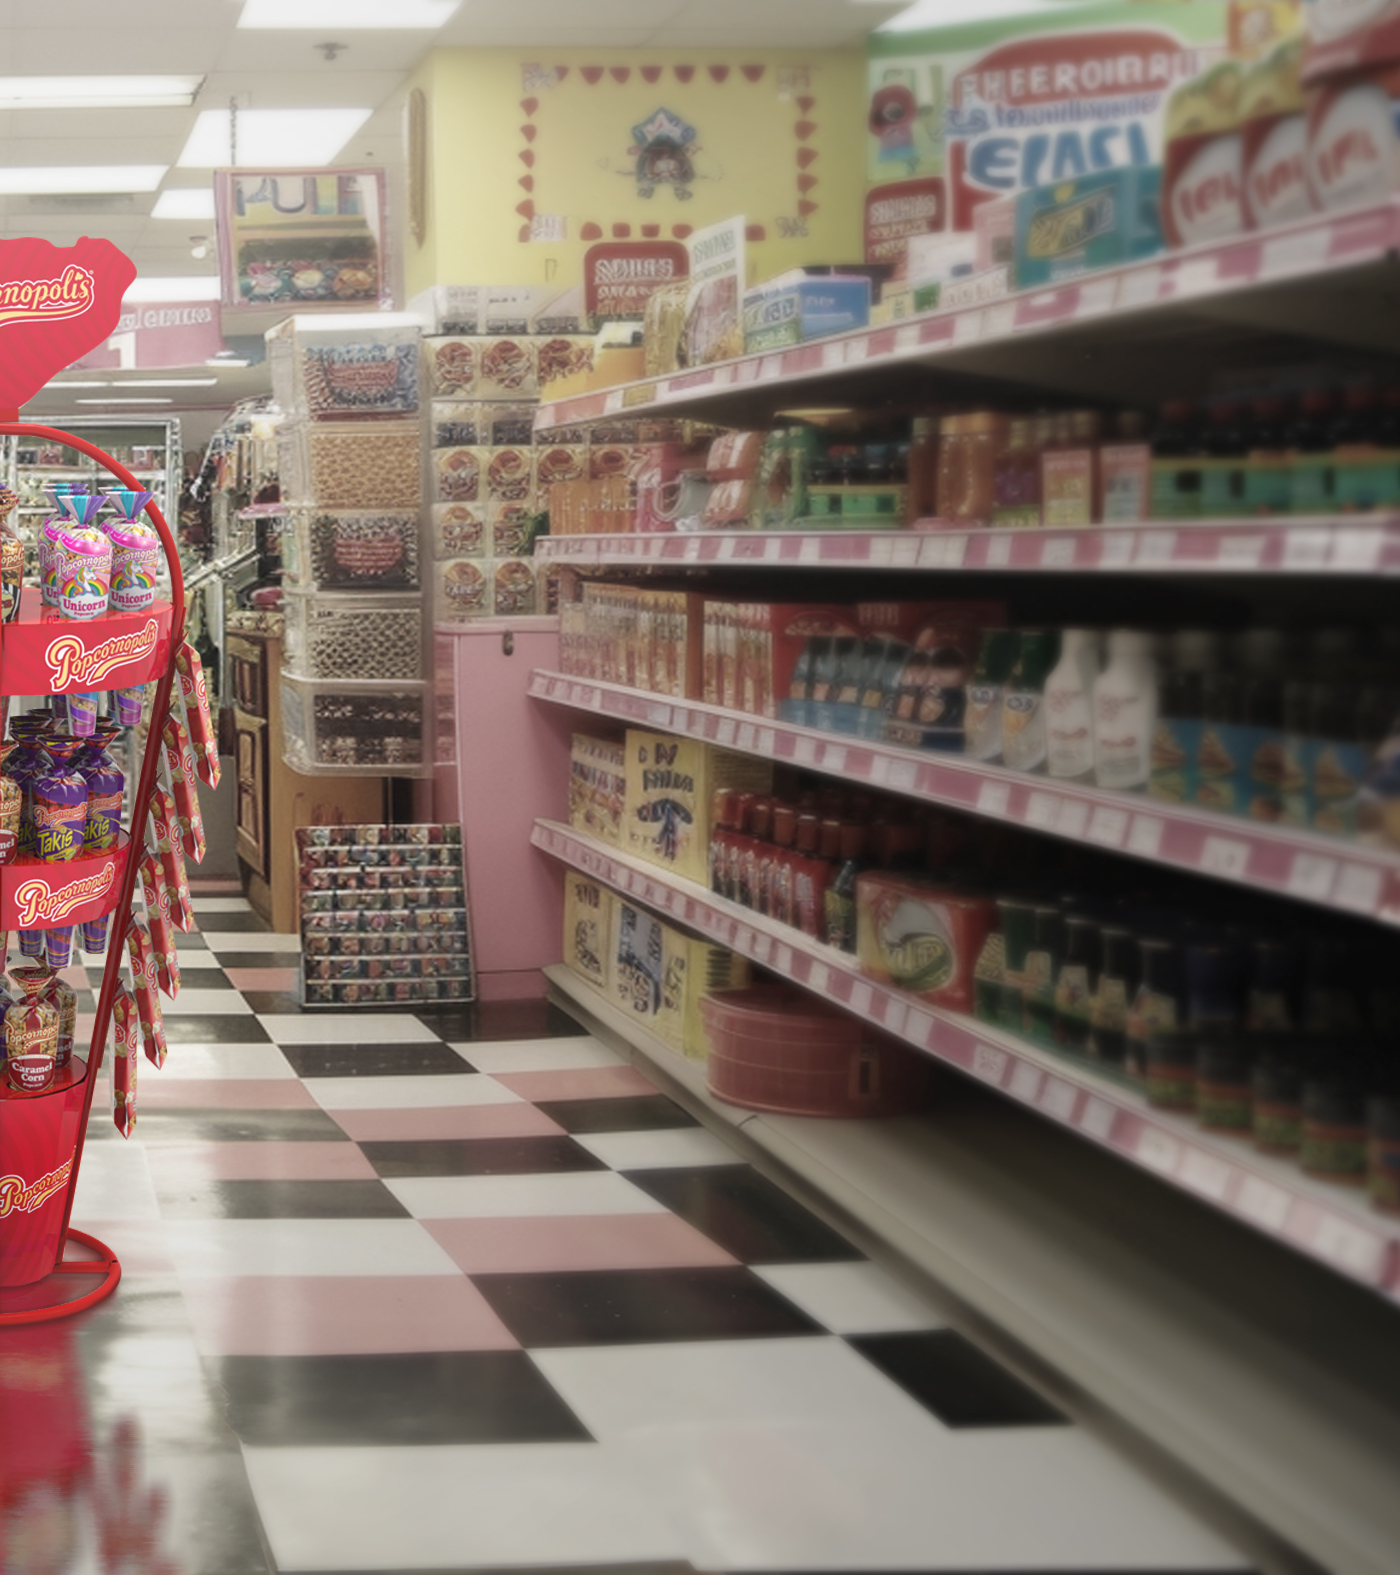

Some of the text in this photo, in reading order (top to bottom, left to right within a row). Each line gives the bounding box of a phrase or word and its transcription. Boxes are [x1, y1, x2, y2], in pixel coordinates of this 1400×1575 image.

[54, 552, 112, 577] Popcornopol
[63, 598, 106, 612] Unicorn
[111, 591, 152, 603] Unicorn
[45, 619, 158, 692] Popcornopolis
[84, 817, 110, 841] akis
[37, 829, 73, 856] Takis
[15, 862, 115, 926] Popcornopolis
[12, 1062, 53, 1074] Caramel
[21, 1073, 45, 1082] Corn
